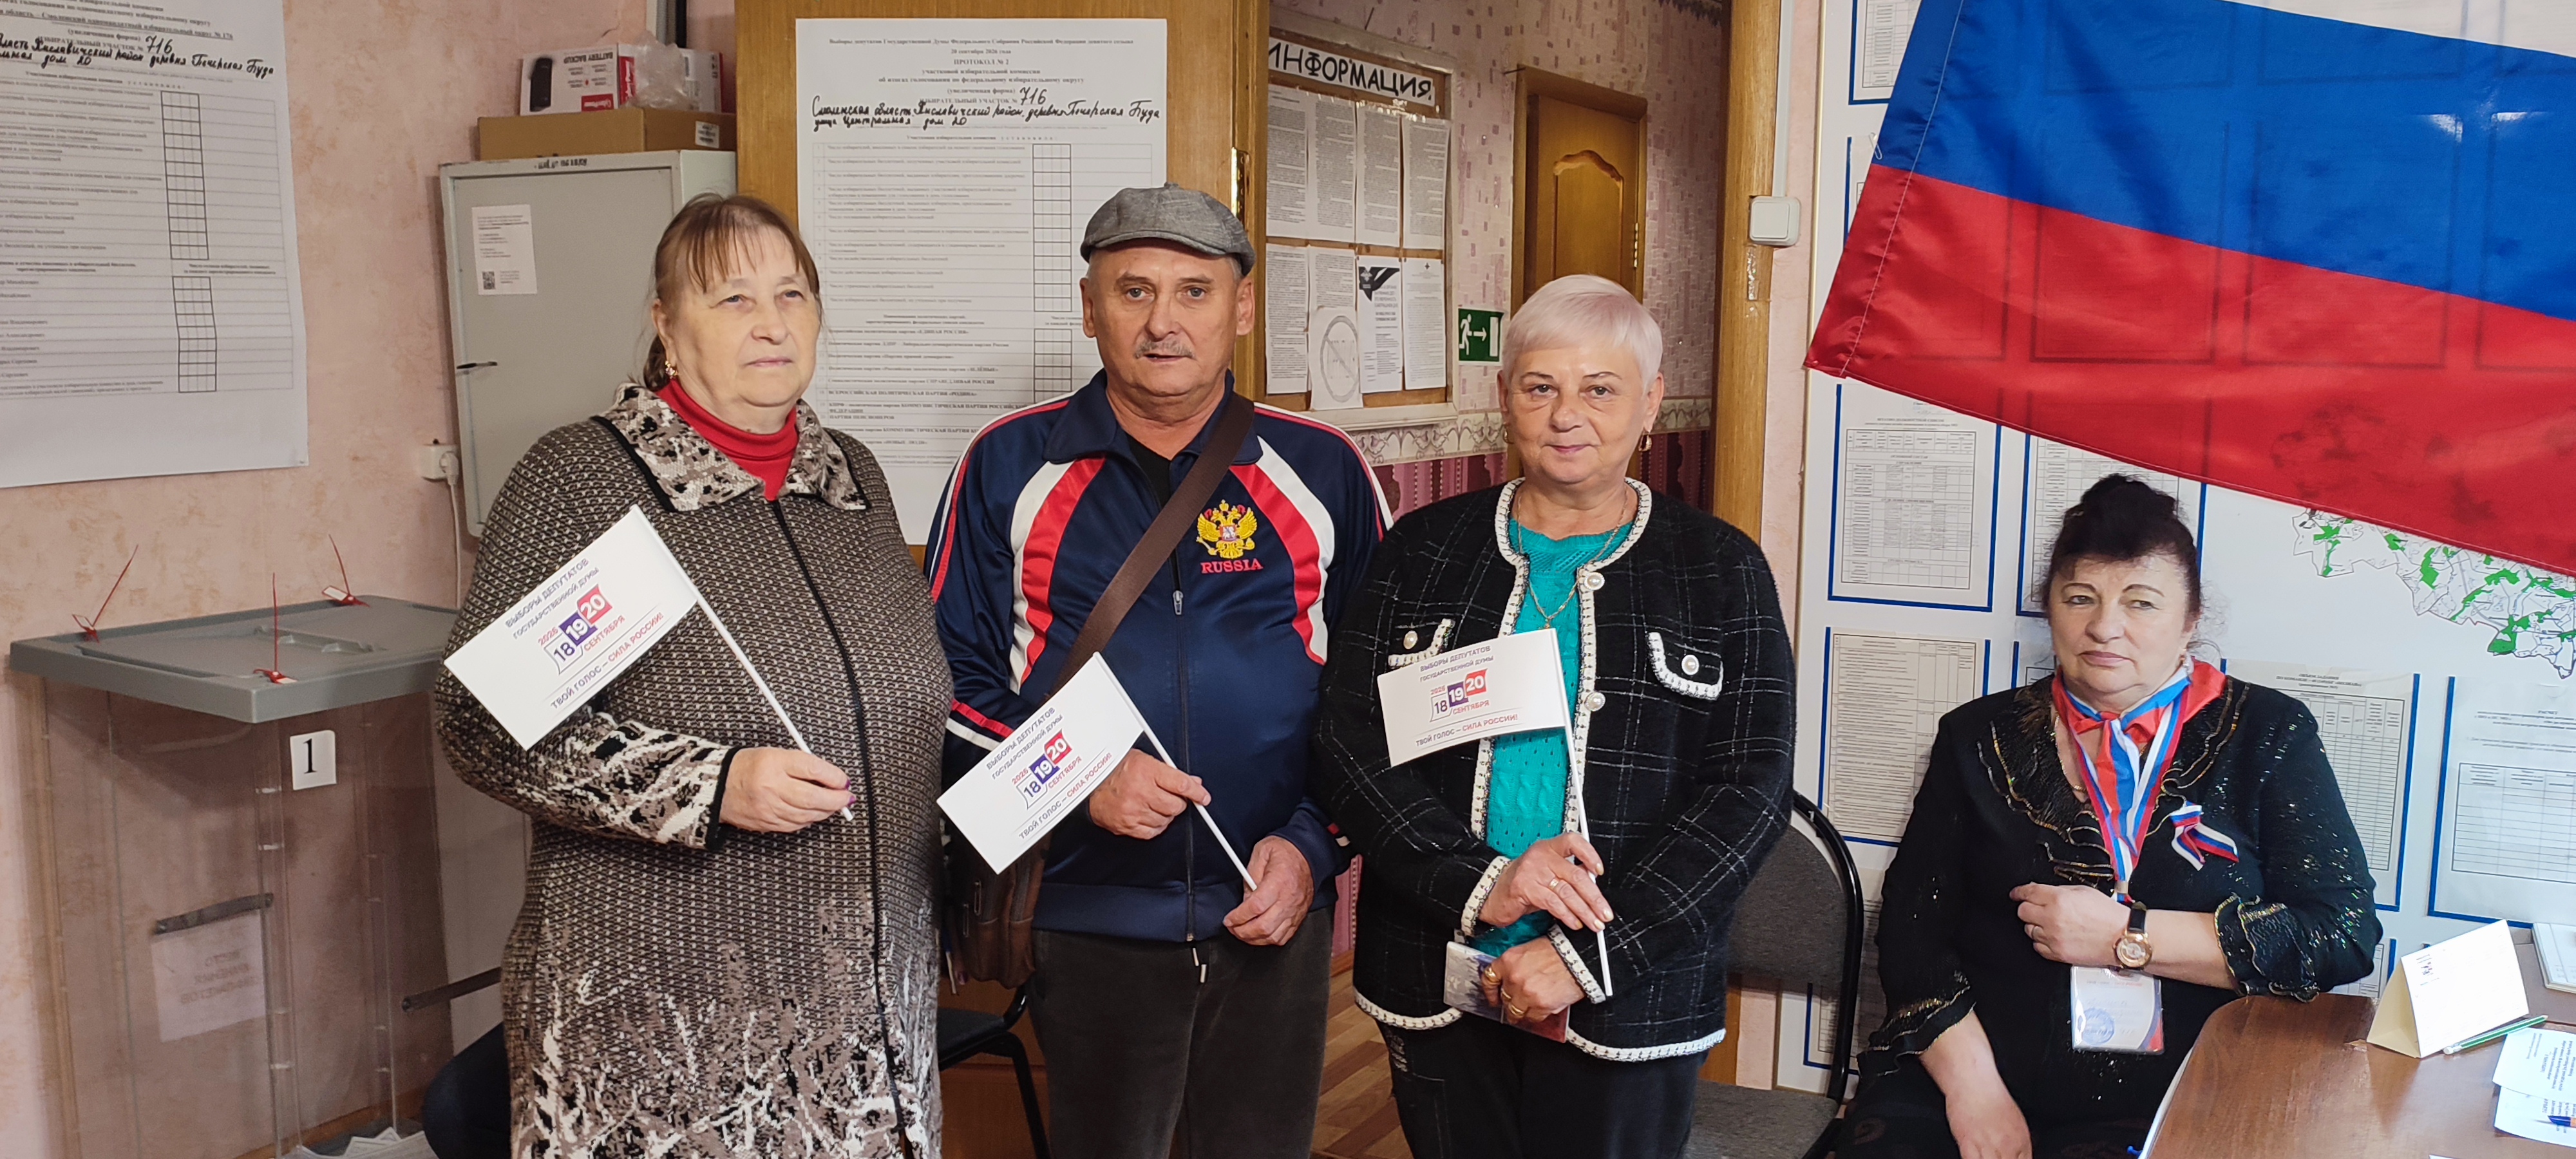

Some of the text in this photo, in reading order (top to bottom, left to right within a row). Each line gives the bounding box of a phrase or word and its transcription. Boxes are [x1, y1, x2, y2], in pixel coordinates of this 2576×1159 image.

[146, 35, 173, 54] 716
[564, 52, 614, 64] BATTERY BACKUP
[1019, 86, 1047, 106] 716
[1200, 558, 1264, 574] RUSSIA
[505, 558, 589, 628] ВЫБОРЫ ДЕПУТАТОВ
[513, 567, 600, 639] ГОСУДАРСТВЕННОЙ ДУМЫ
[538, 627, 558, 645] 2026
[553, 595, 605, 662] 18 19 20
[583, 616, 625, 652] СЕНТЯБРЯ
[551, 687, 575, 709] ТВОЙ
[574, 666, 601, 690] ГОЛОС
[607, 642, 631, 663] СИЛА
[630, 612, 664, 644] РОССИИ!
[1420, 645, 1491, 672] ВЫБОРЫ ДЕПУТАТОВ
[1420, 655, 1493, 682] ГОСУДАРСТВЕННОЙ ДУМЫ
[1430, 686, 1445, 694] 2026
[1434, 675, 1484, 714] 18 19 20
[1453, 700, 1489, 715] СЕНТЯБРЯ
[987, 707, 1056, 769] ВЫБОРЫ ДЕПУТАТОВ
[1416, 734, 1432, 746] ТВОЙ
[1434, 729, 1455, 739] ГОЛОС
[1463, 721, 1481, 731] СИЛА
[1484, 714, 1518, 726] РОССИИ!
[303, 739, 317, 775] 1
[992, 715, 1063, 780] ГОСУДАРСТВЕННОЙ ДУМЫ
[1011, 768, 1029, 784] 2026
[1023, 740, 1066, 798] 18 19 20
[1048, 756, 1082, 789] СЕНТЯБРЯ
[1018, 818, 1039, 839] ТВОЙ
[1039, 800, 1061, 822] ГОЛОС
[1066, 779, 1086, 798] СИЛА
[1085, 753, 1112, 781] РОССИИ!
